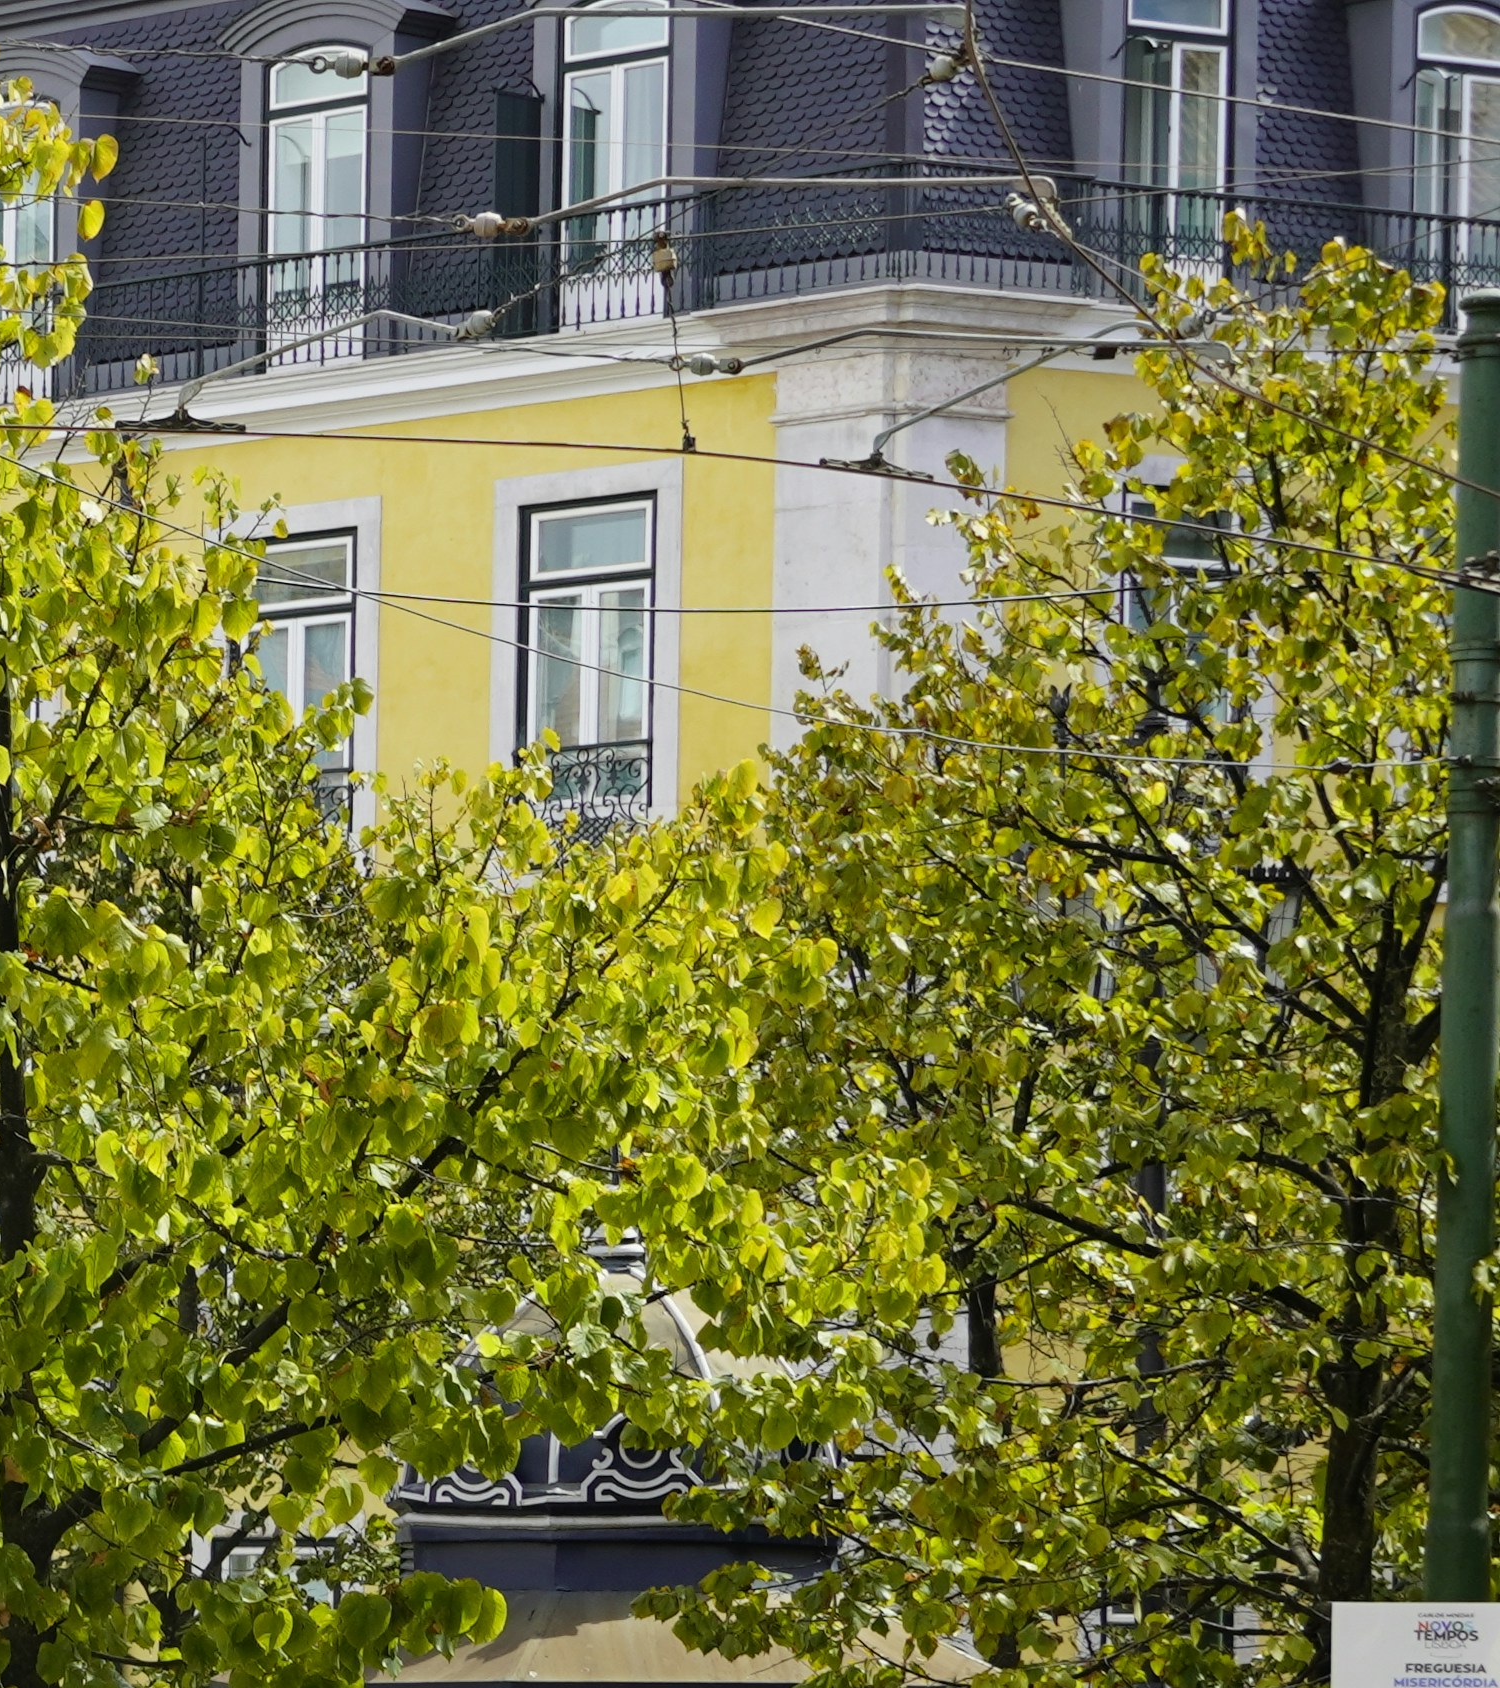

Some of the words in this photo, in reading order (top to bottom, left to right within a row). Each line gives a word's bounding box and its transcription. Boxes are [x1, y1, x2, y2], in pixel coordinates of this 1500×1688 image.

[1418, 1620, 1474, 1632] NOVOS
[1414, 1630, 1479, 1642] TEMPOS
[1405, 1663, 1487, 1674] FREGUESIA
[1394, 1675, 1498, 1688] MISERICÓRDIA
